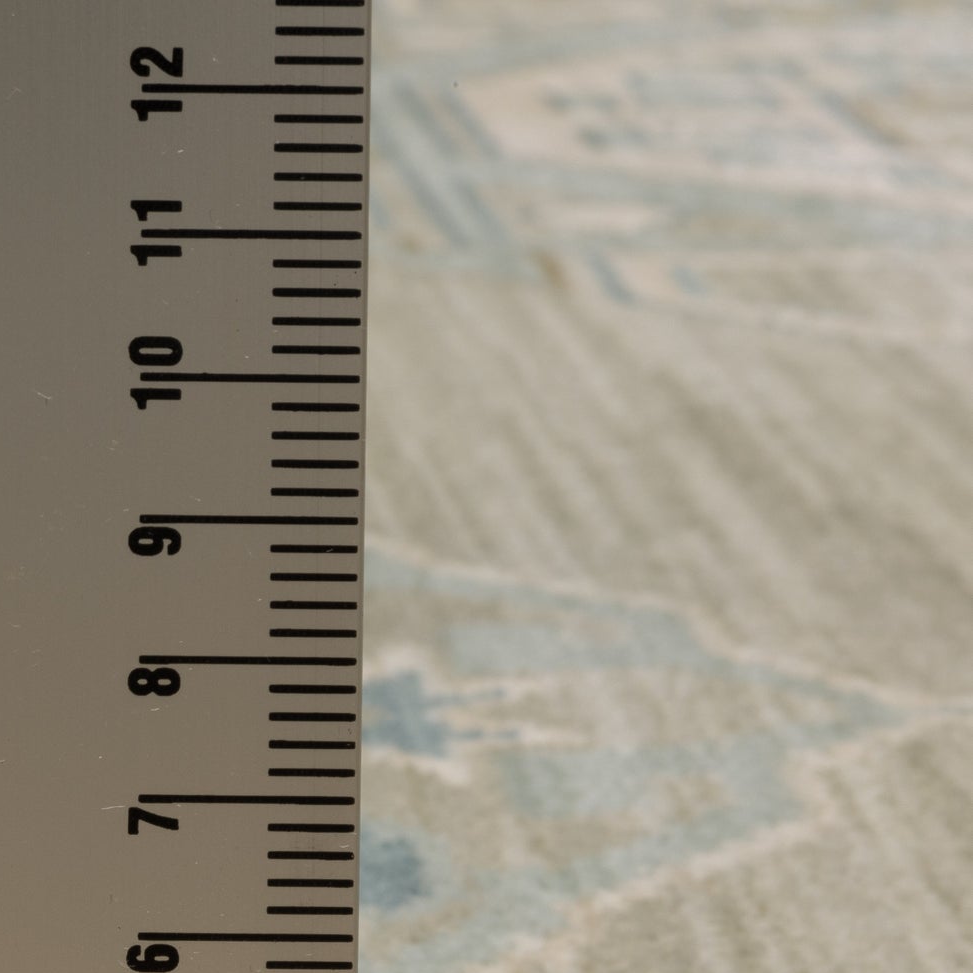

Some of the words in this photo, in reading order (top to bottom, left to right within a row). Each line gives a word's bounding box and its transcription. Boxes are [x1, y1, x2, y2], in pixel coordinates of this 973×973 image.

[130, 47, 183, 121] 12
[130, 200, 182, 266] 11
[128, 336, 183, 410] 10
[128, 526, 182, 556] 9
[128, 667, 181, 696] 8
[128, 807, 180, 835] 7
[126, 944, 179, 973] 6
